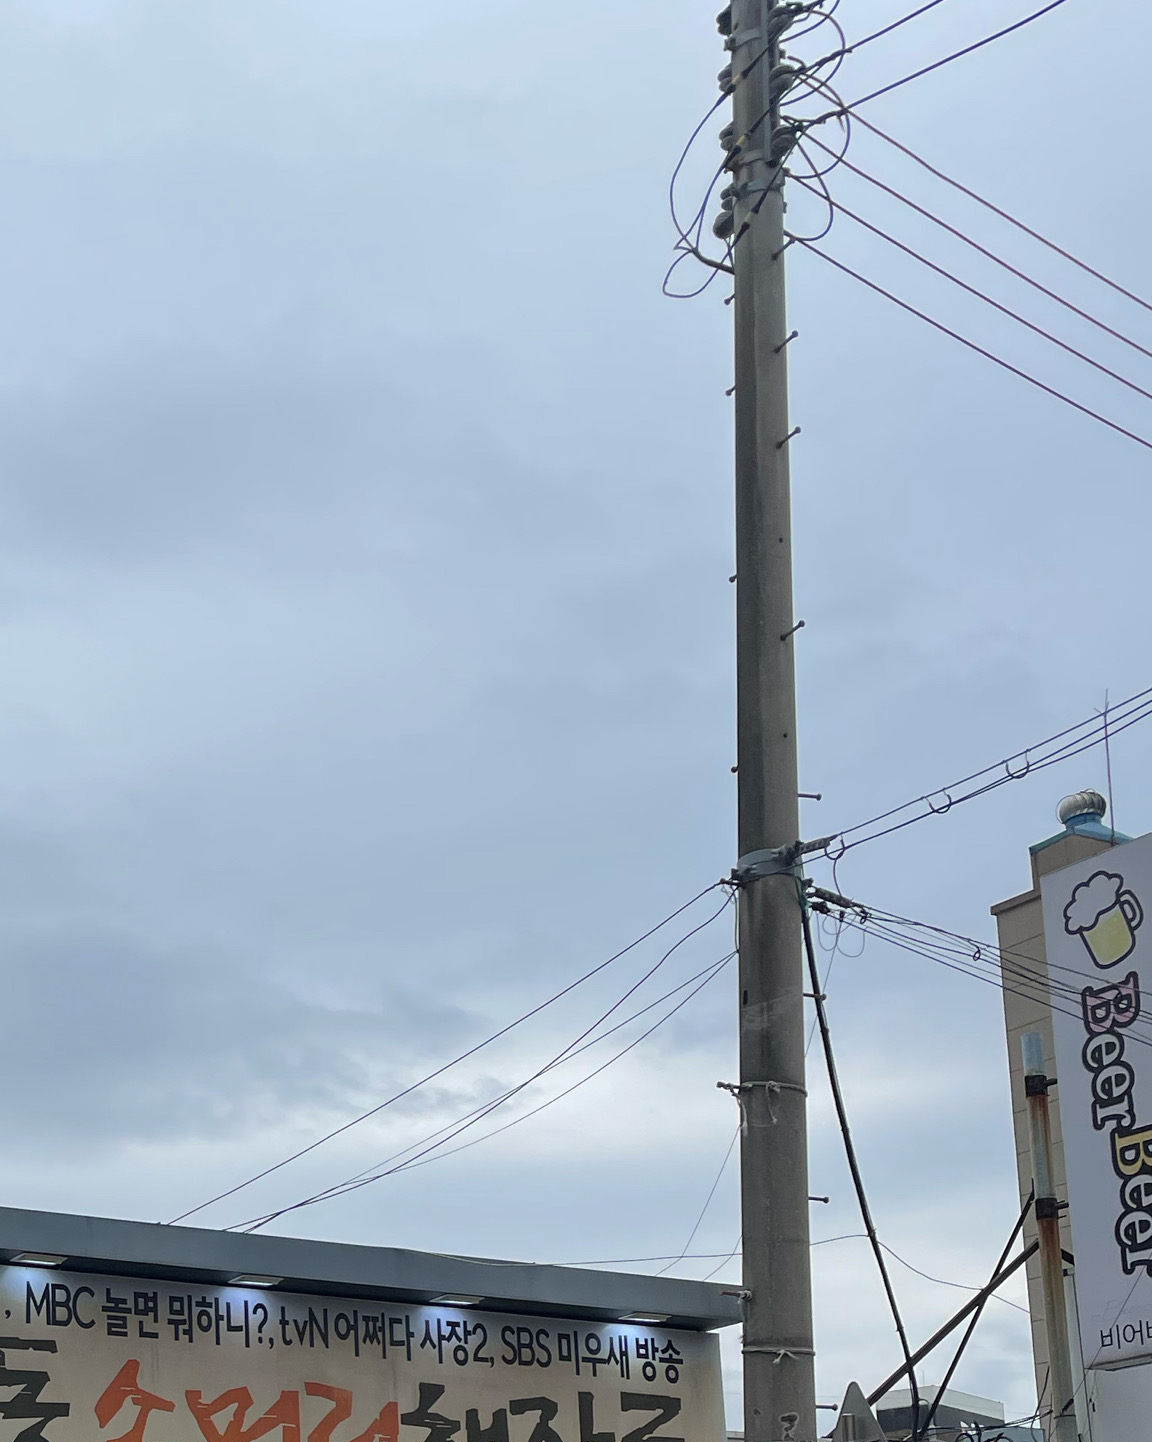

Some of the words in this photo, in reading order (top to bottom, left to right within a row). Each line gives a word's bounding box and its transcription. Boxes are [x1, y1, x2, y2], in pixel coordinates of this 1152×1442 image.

[1081, 971, 1141, 1131] Beer
[26, 1281, 96, 1329] MBC
[101, 1287, 159, 1339] 놀면
[279, 1306, 329, 1349] tvN
[334, 1309, 415, 1361] 어쩌다
[420, 1318, 495, 1368] 사장2,
[501, 1326, 552, 1368] SBS
[558, 1331, 630, 1380] 미우새
[635, 1337, 684, 1384] 방송
[1100, 1320, 1152, 1350] 비어
